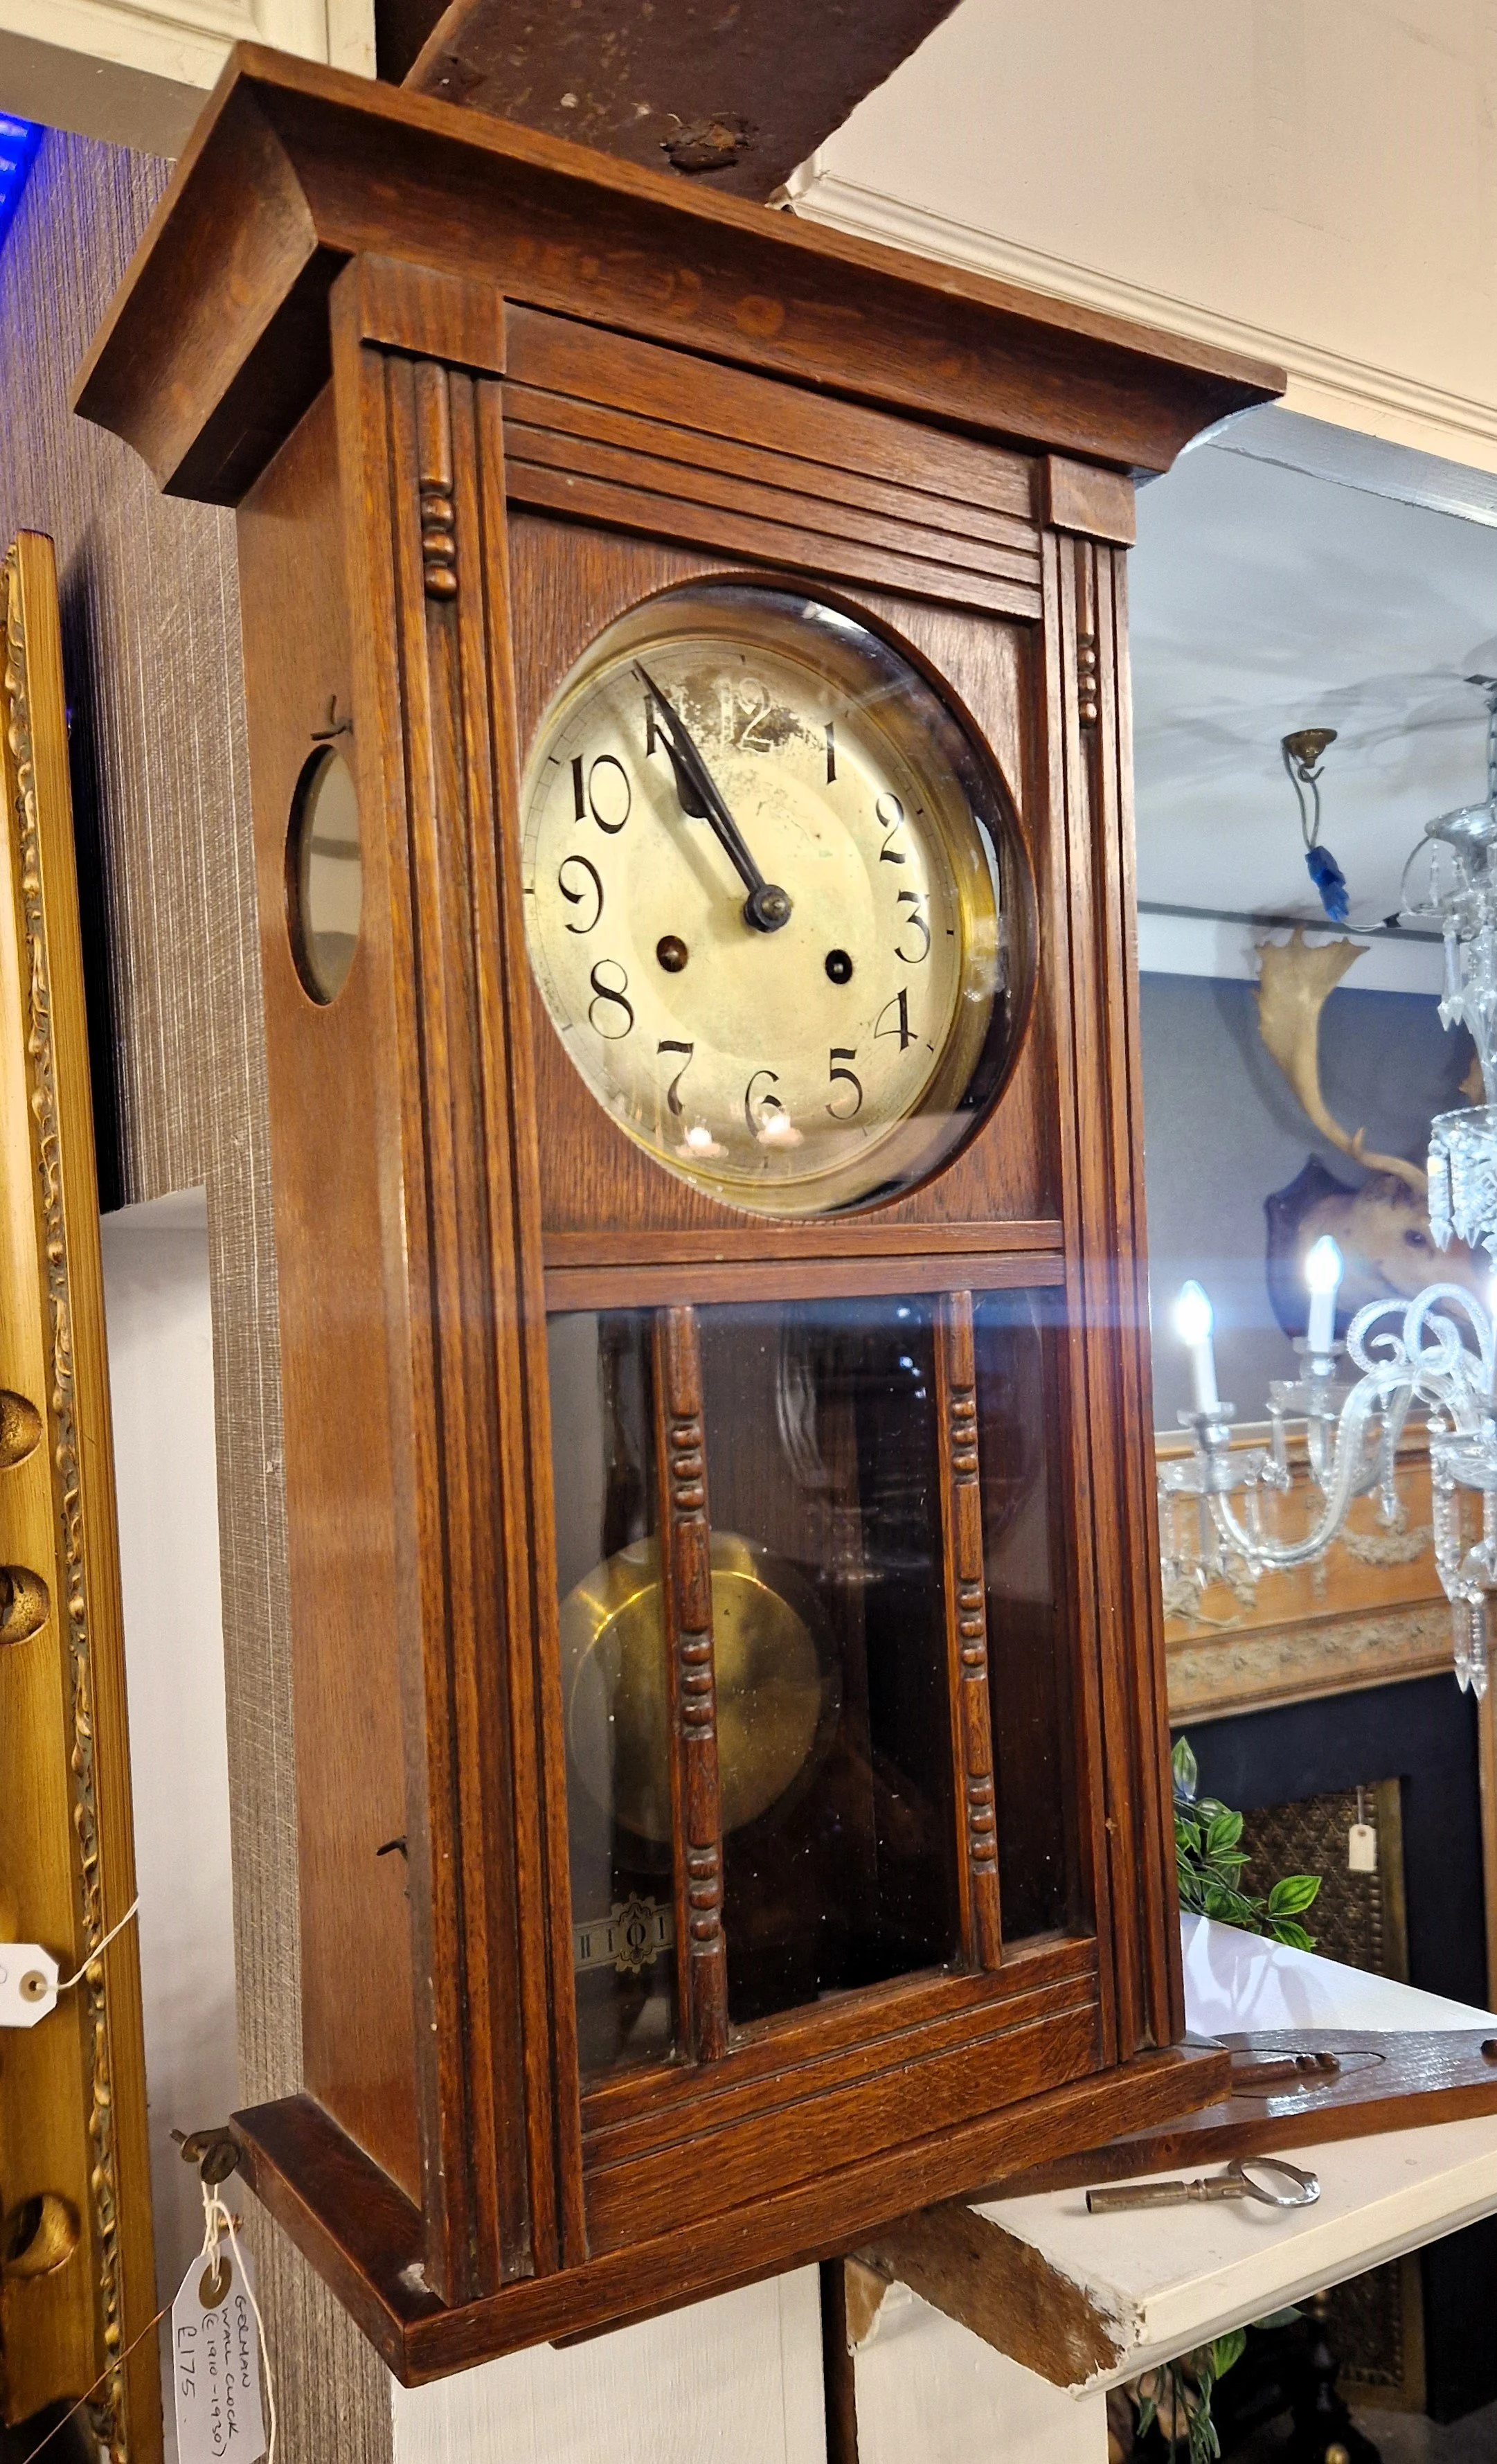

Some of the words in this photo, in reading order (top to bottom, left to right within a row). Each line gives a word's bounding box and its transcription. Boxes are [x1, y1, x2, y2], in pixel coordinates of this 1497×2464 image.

[719, 677, 773, 753] 12
[825, 721, 837, 785] 1
[571, 753, 631, 834] 10
[875, 792, 905, 864] 2
[557, 855, 603, 934] 9
[893, 891, 931, 964] 3
[588, 959, 634, 1040] 8
[874, 987, 918, 1051] 4
[656, 1039, 694, 1116] 7
[744, 1070, 782, 1139] 6
[825, 1048, 863, 1120] 5
[177, 2325, 197, 2399] £175
[222, 2307, 231, 2366] WALL
[224, 2373, 240, 2438] CLOCK
